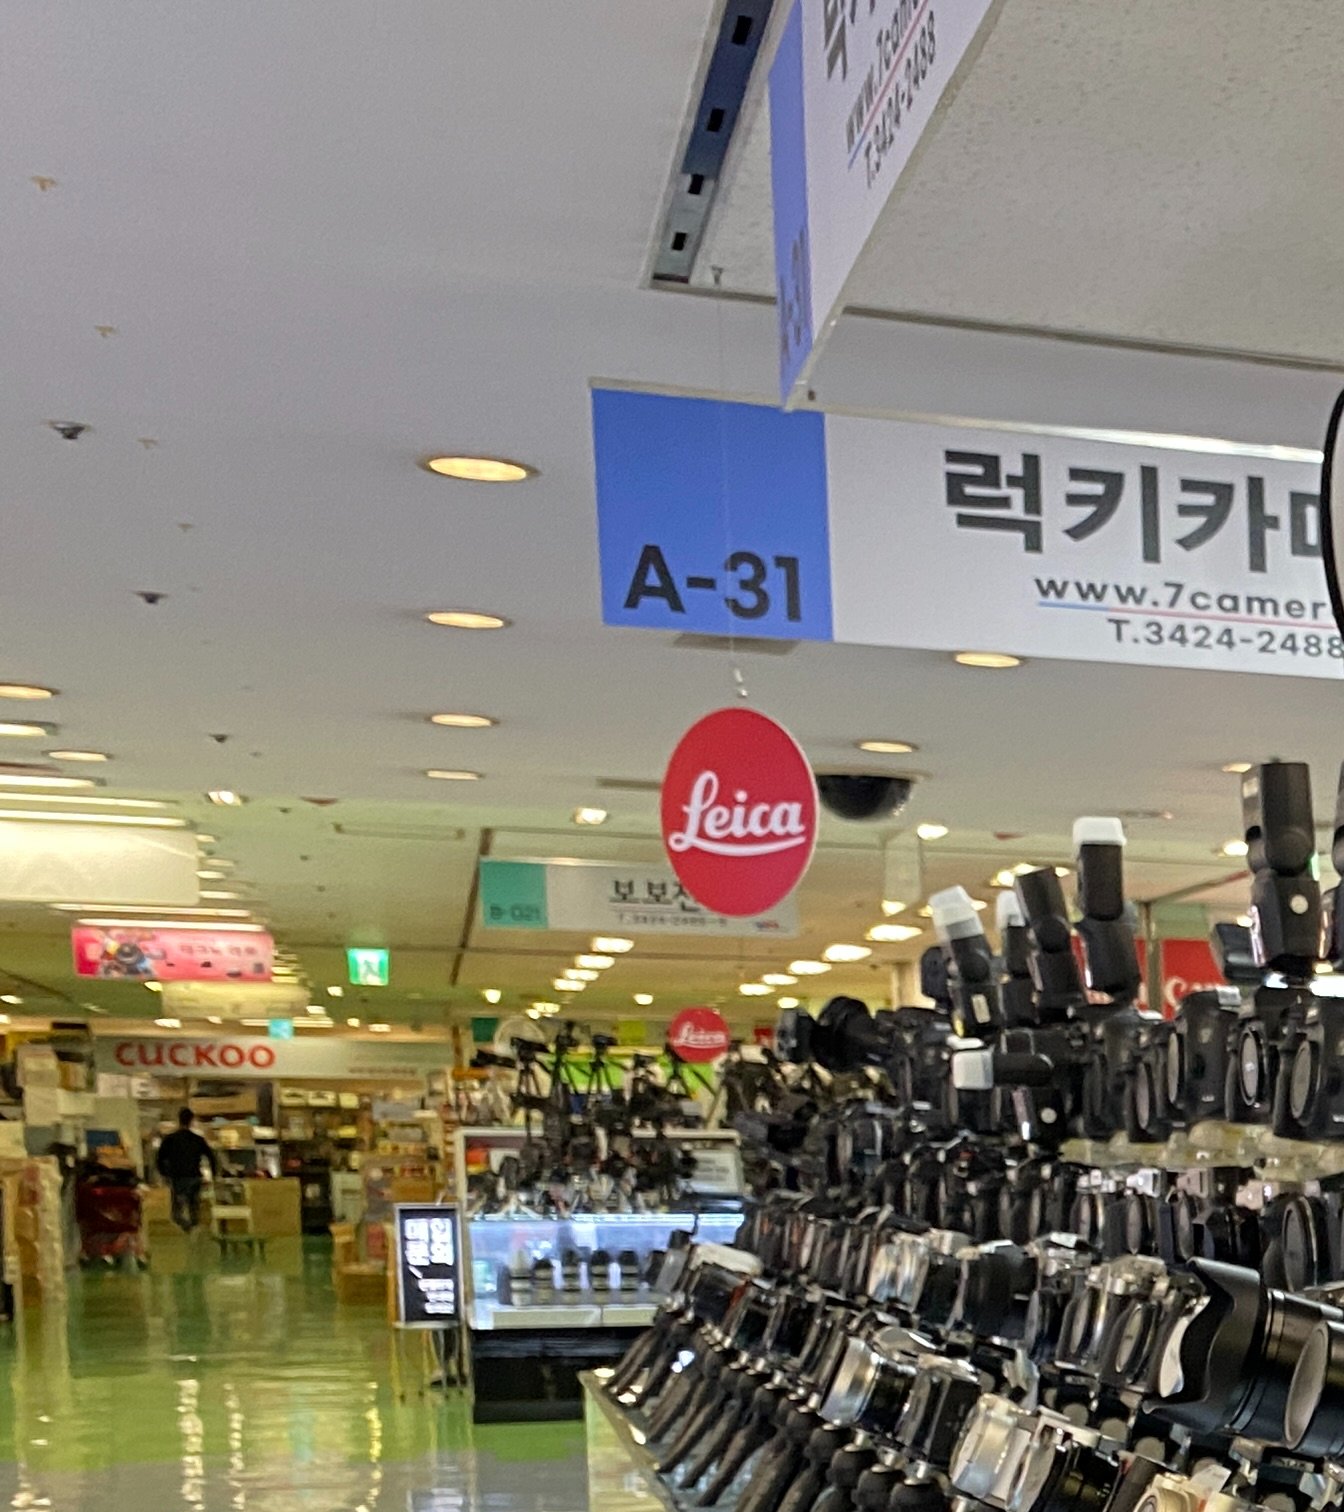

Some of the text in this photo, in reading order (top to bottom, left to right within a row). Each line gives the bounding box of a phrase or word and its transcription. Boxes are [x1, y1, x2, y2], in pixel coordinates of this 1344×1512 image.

[623, 542, 803, 624] A-31
[1034, 577, 1334, 622] www.7camer
[1107, 617, 1344, 662] T.3424-2488
[668, 770, 806, 857] Leica
[115, 1041, 276, 1069] CUCKOO
